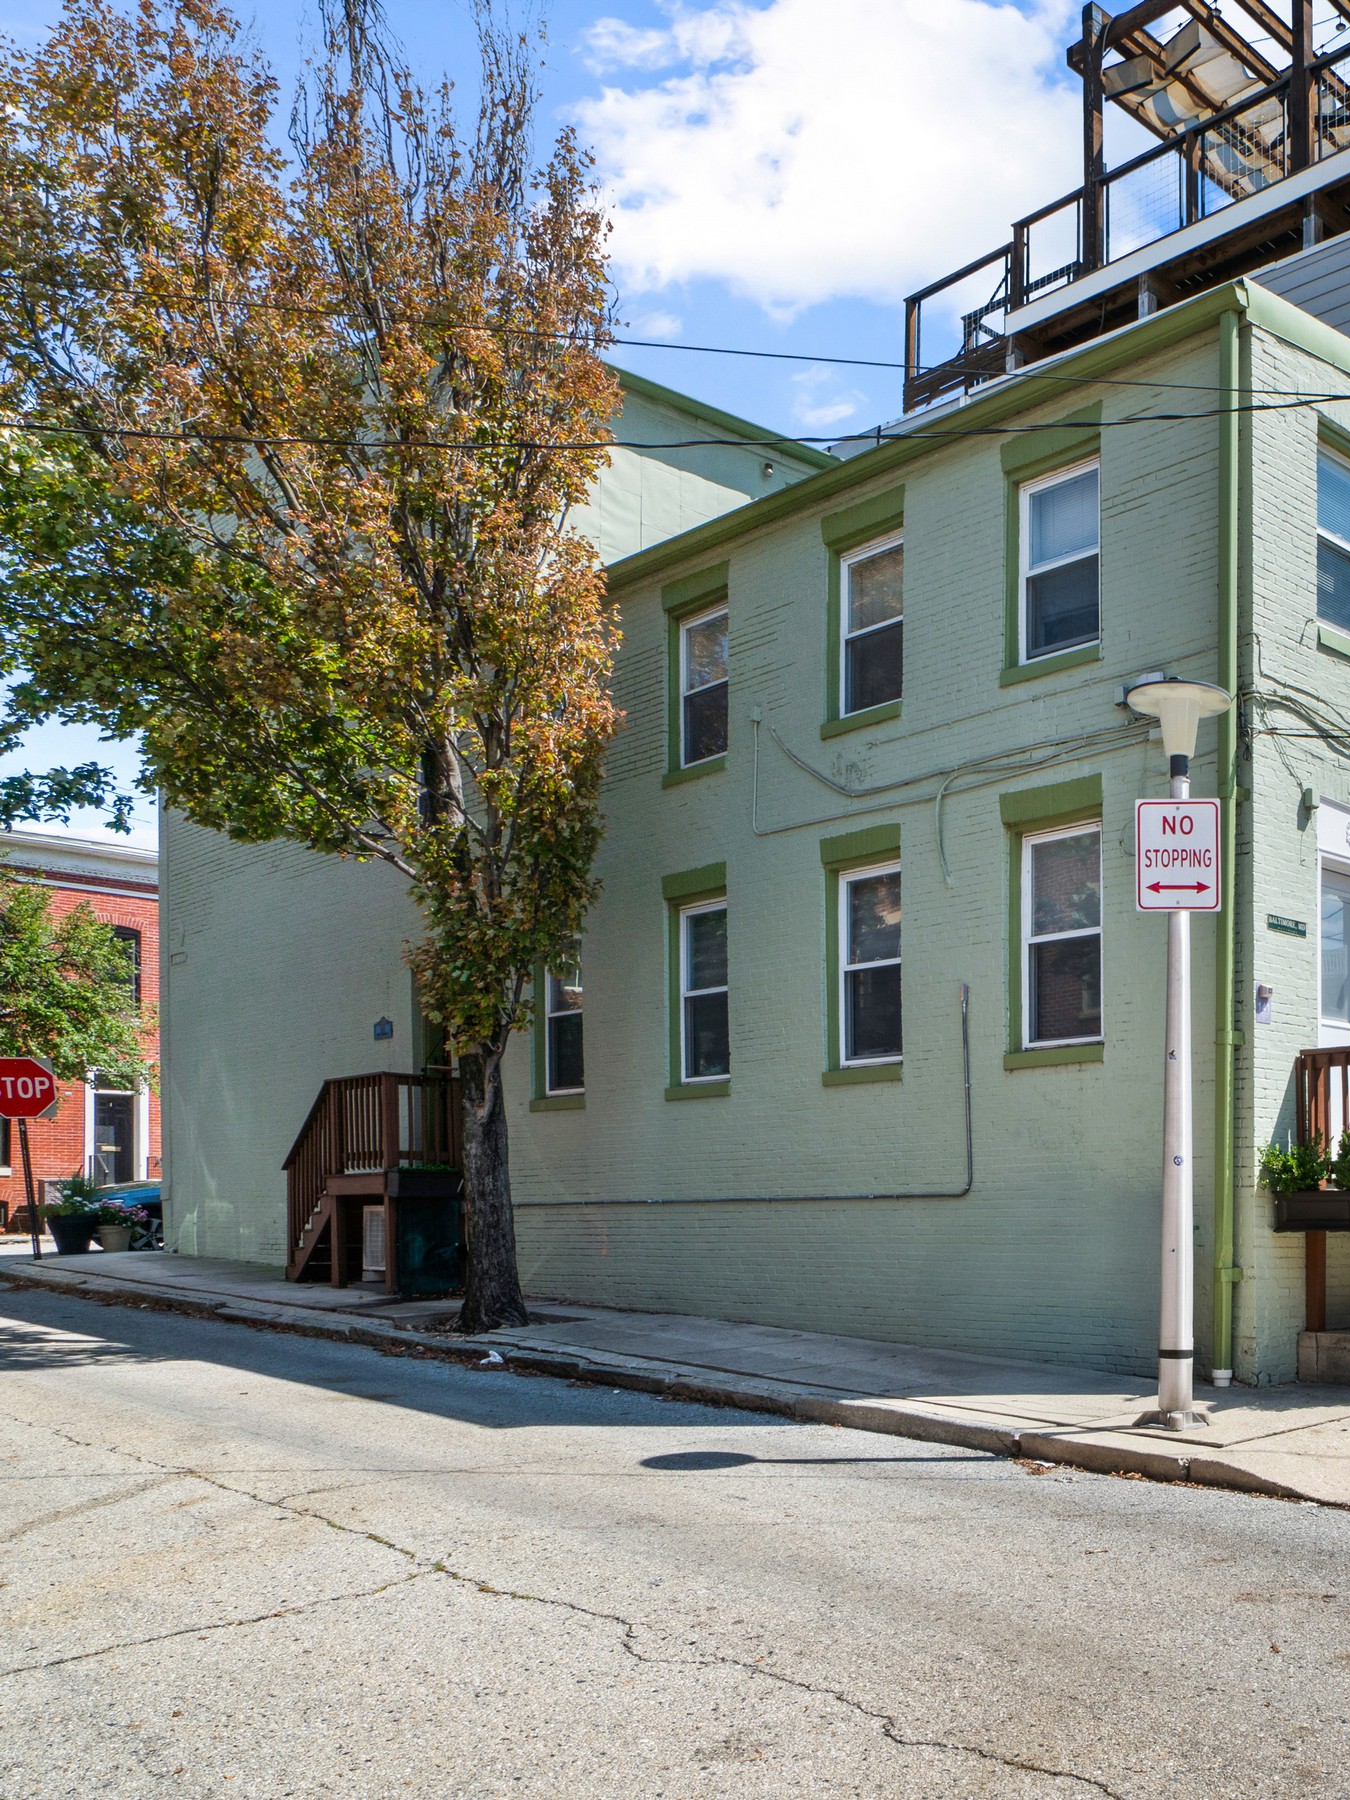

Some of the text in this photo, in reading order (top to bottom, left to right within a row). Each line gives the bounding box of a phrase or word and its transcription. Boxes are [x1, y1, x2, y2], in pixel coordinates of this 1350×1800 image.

[1162, 815, 1194, 835] NO
[1144, 848, 1212, 868] STOPPING
[0, 1077, 50, 1099] TOP
